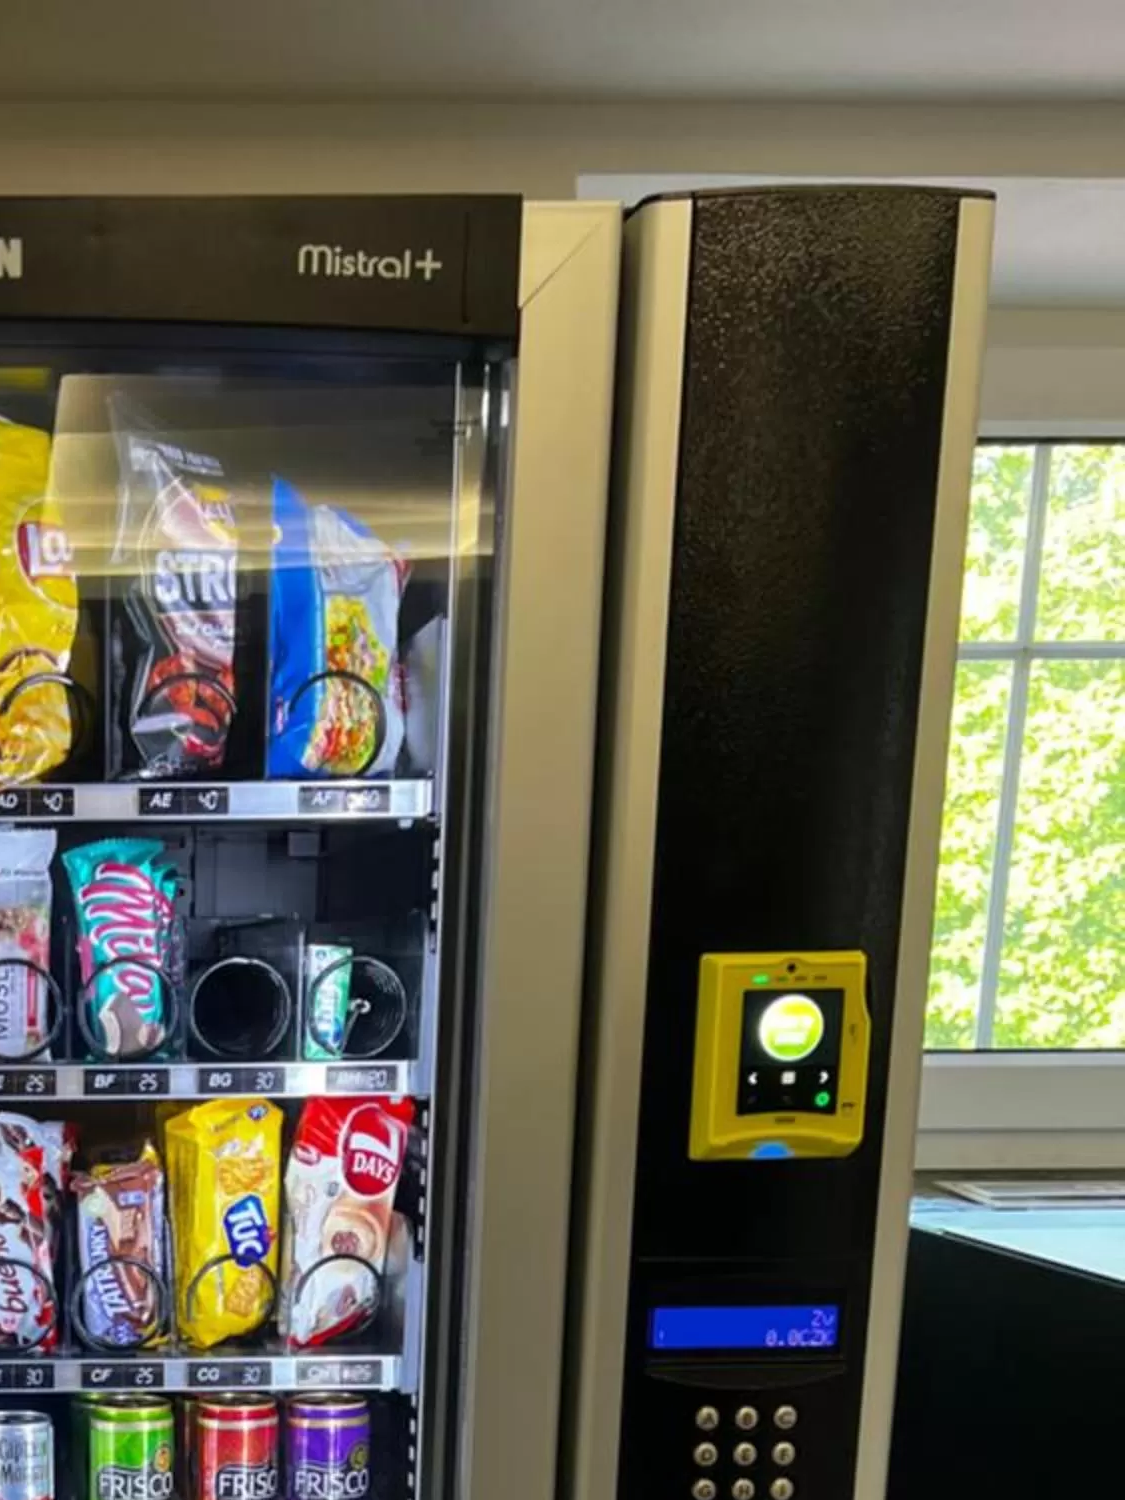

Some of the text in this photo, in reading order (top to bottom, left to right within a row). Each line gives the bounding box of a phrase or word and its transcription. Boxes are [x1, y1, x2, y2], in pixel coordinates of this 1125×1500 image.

[149, 793, 172, 808] AE
[93, 1073, 158, 1092] BF 25
[208, 1071, 274, 1090] BG 30
[349, 1112, 400, 1165] 7
[352, 1151, 397, 1186] DAYS
[226, 1200, 264, 1257] TUC
[25, 1368, 44, 1387] 30
[90, 1367, 154, 1385] CF 25
[197, 1366, 261, 1384] CG 30
[98, 1470, 174, 1498] FRISCO
[293, 1469, 369, 1497] FRISCO
